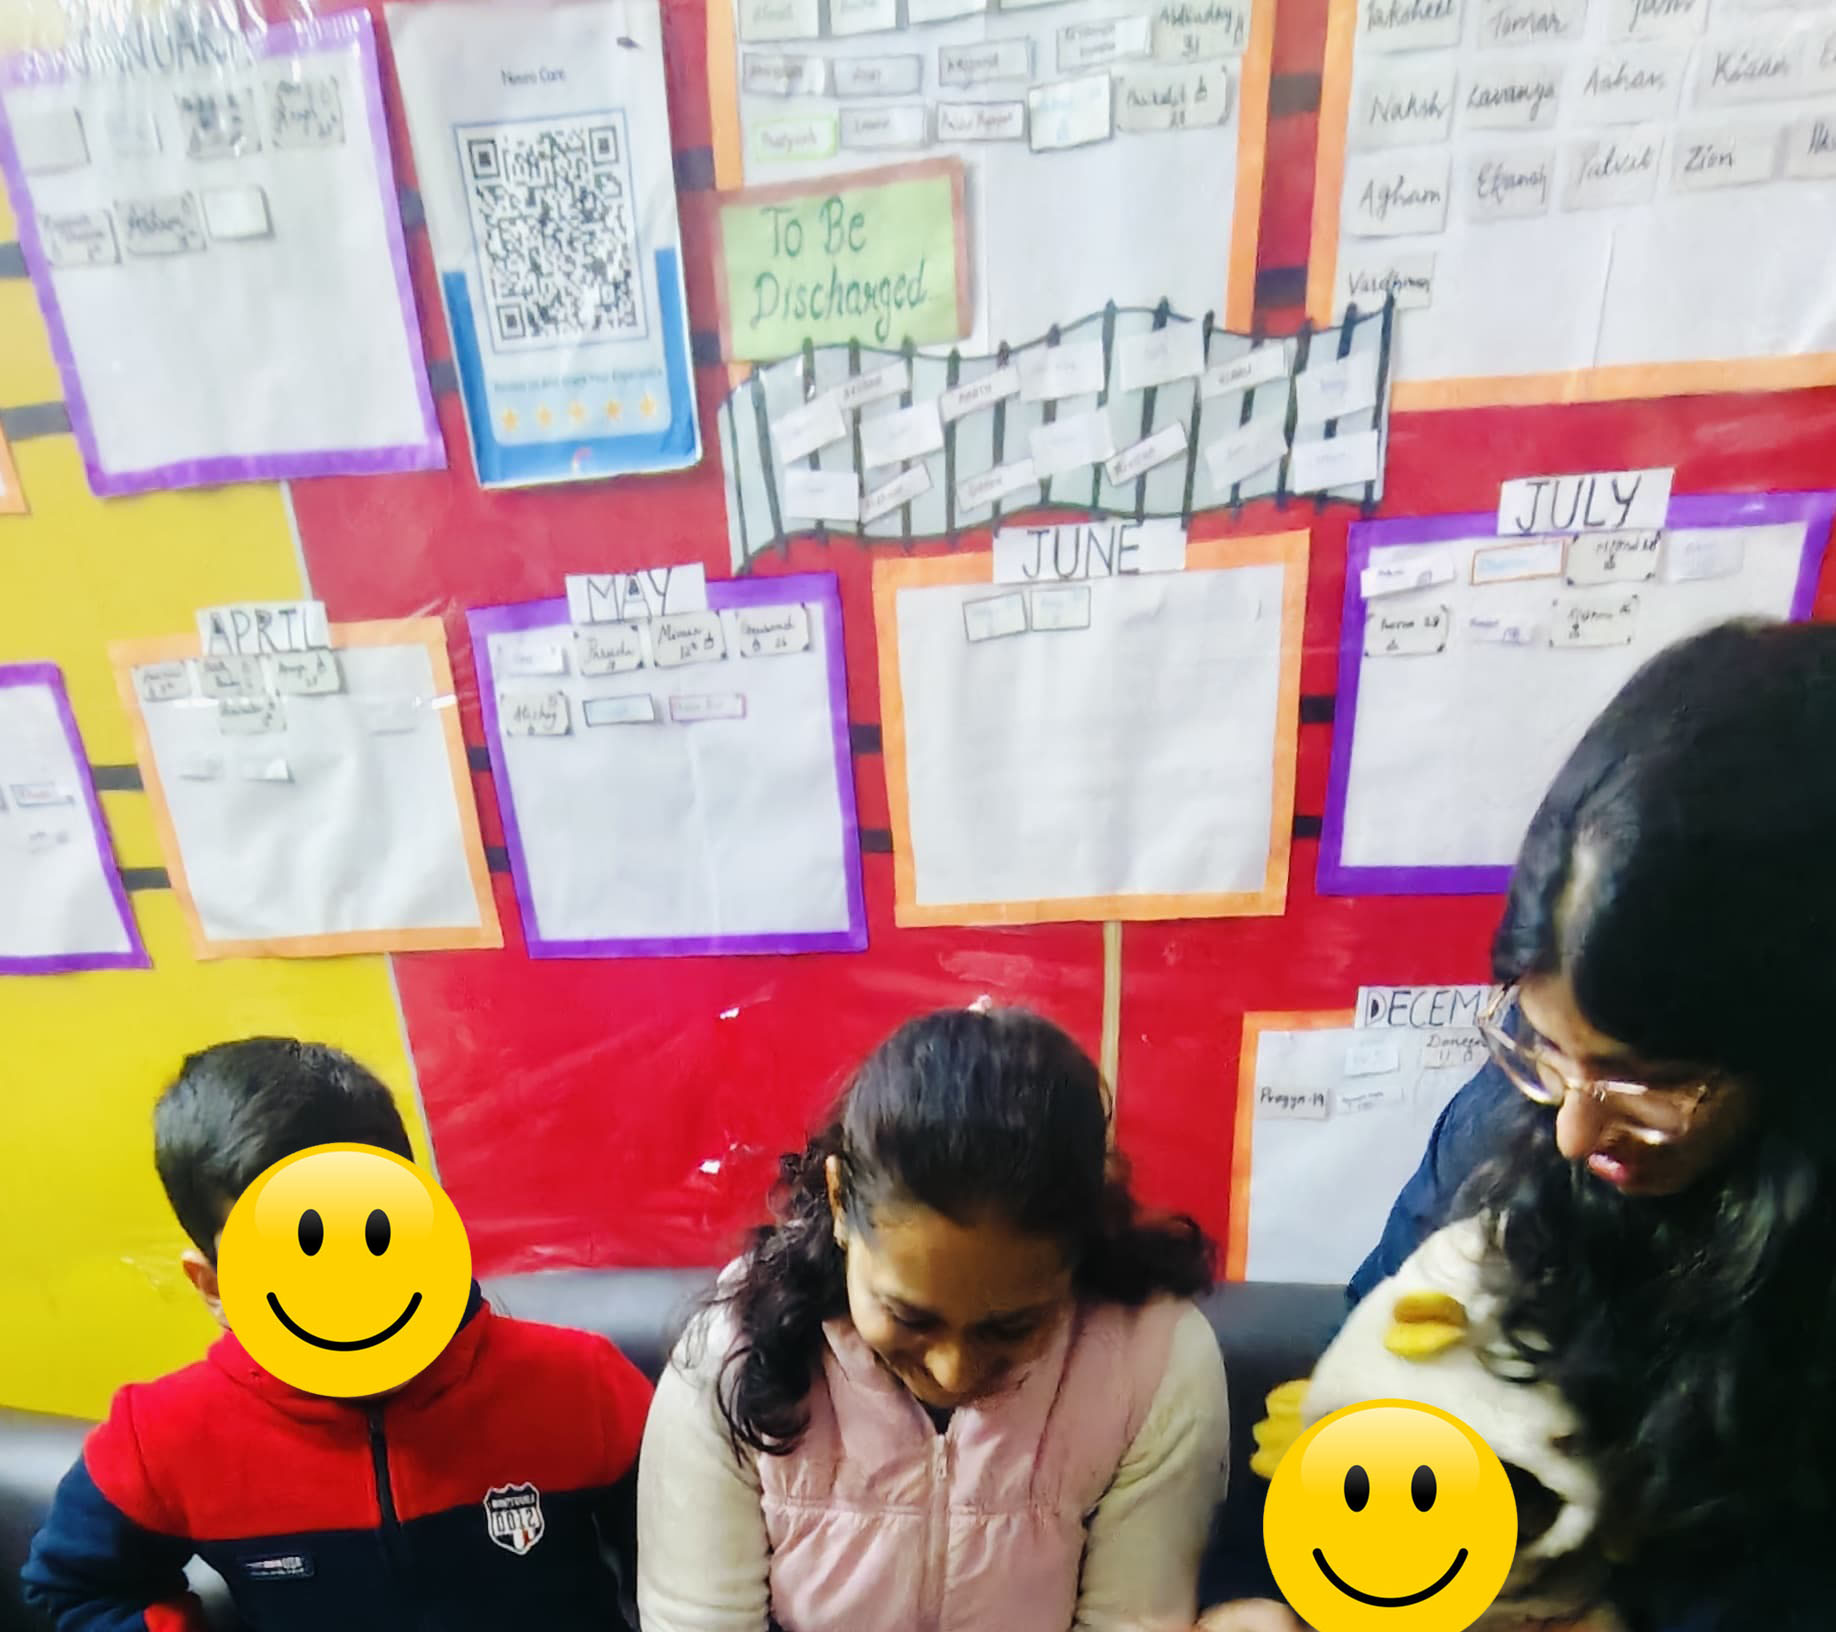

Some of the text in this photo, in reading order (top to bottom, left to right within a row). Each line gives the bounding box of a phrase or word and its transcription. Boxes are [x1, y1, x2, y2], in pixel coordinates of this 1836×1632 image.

[760, 195, 867, 257] To Be
[750, 255, 927, 344] Discharged
[1515, 474, 1642, 535] JULY
[1022, 523, 1143, 581] JUNE
[587, 566, 672, 623] MAY
[208, 607, 329, 656] APRIL
[1364, 989, 1483, 1030] DECEM
